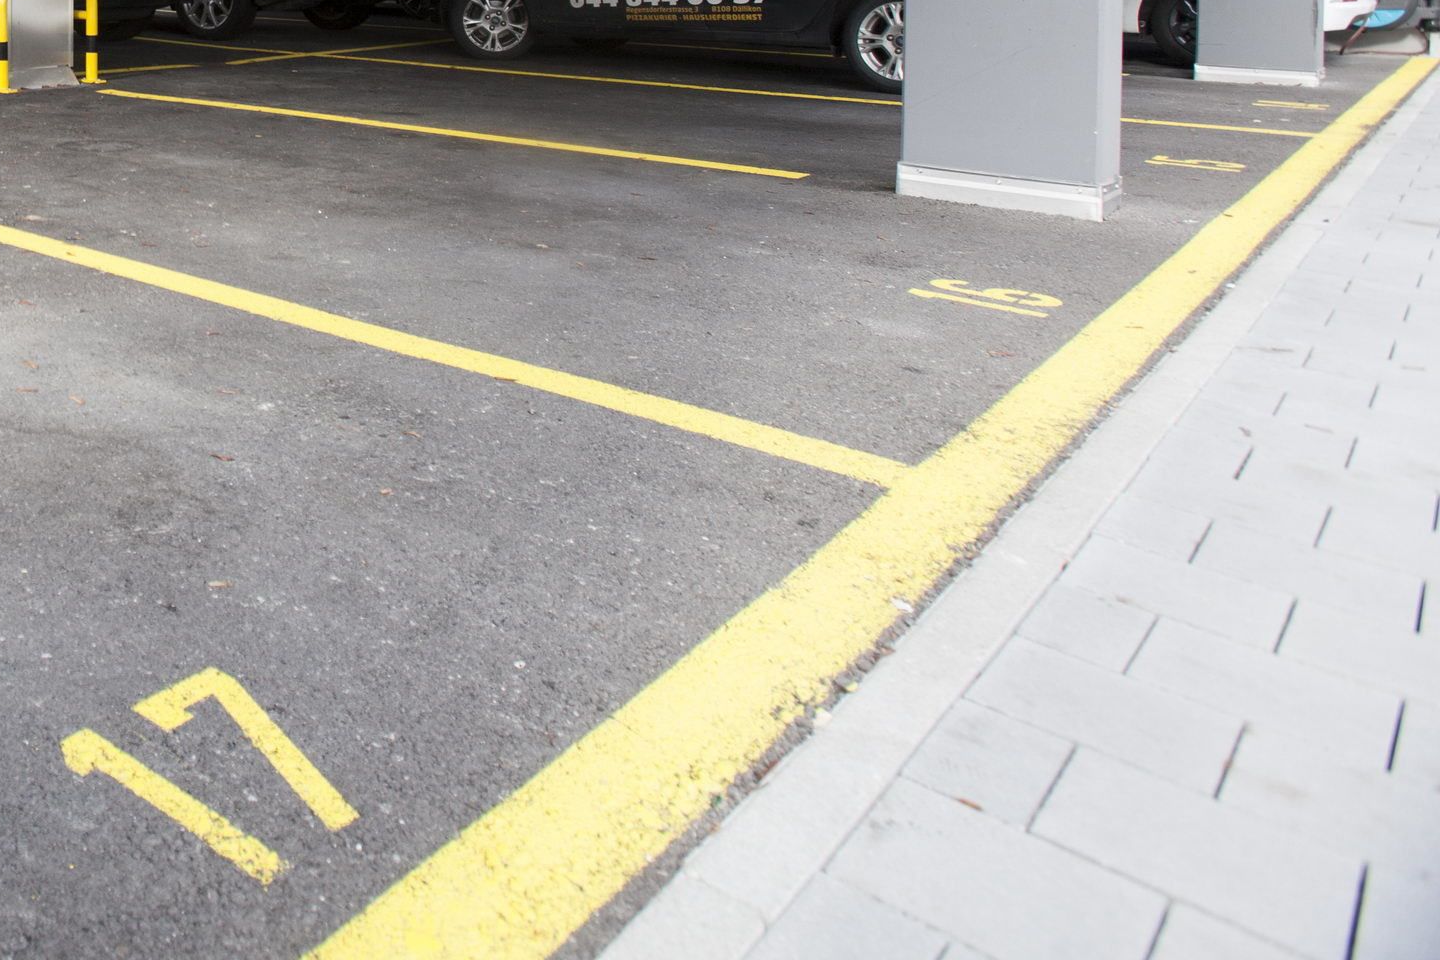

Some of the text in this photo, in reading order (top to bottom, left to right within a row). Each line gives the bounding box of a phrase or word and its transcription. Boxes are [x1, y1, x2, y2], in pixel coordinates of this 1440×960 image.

[682, 12, 763, 21] HAUSLIEFERDIENST
[1144, 155, 1246, 172] 15
[908, 279, 1063, 318] 16
[60, 666, 360, 891] 17
